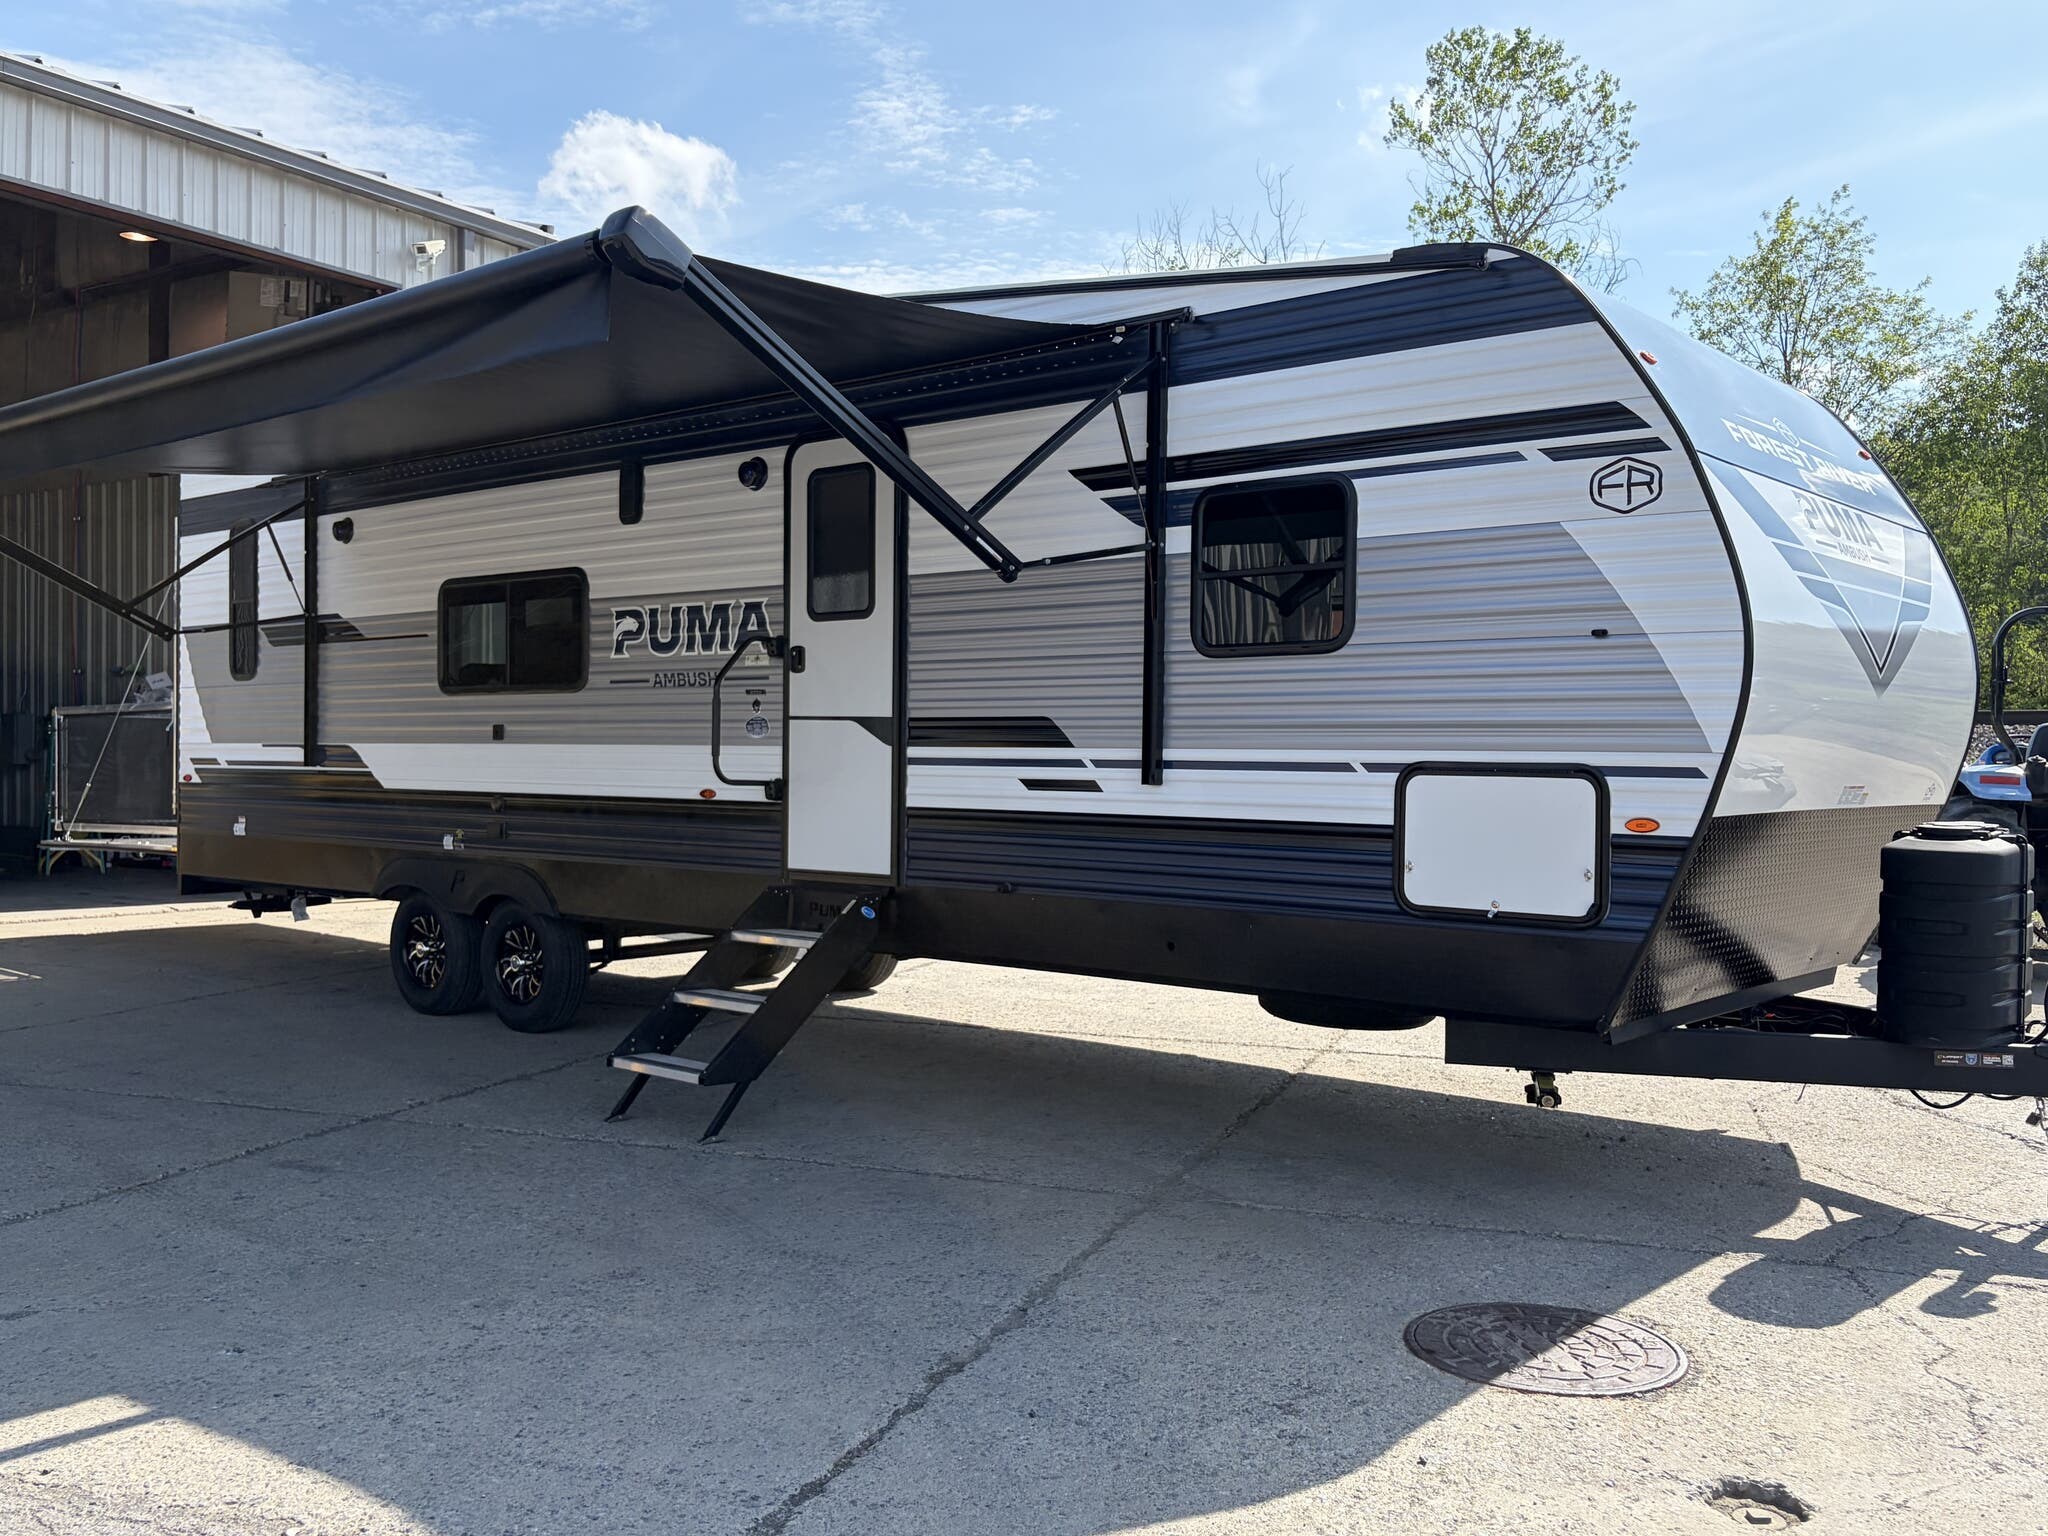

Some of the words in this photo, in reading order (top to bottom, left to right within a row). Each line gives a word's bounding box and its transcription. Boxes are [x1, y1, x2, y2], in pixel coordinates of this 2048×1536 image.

[1720, 418, 1814, 472] FOREST
[1810, 454, 1877, 497] RIVER
[1790, 489, 1885, 553] PUMA
[610, 597, 773, 658] PUMA
[653, 671, 719, 688] AMBUSH
[809, 901, 844, 918] PUM
